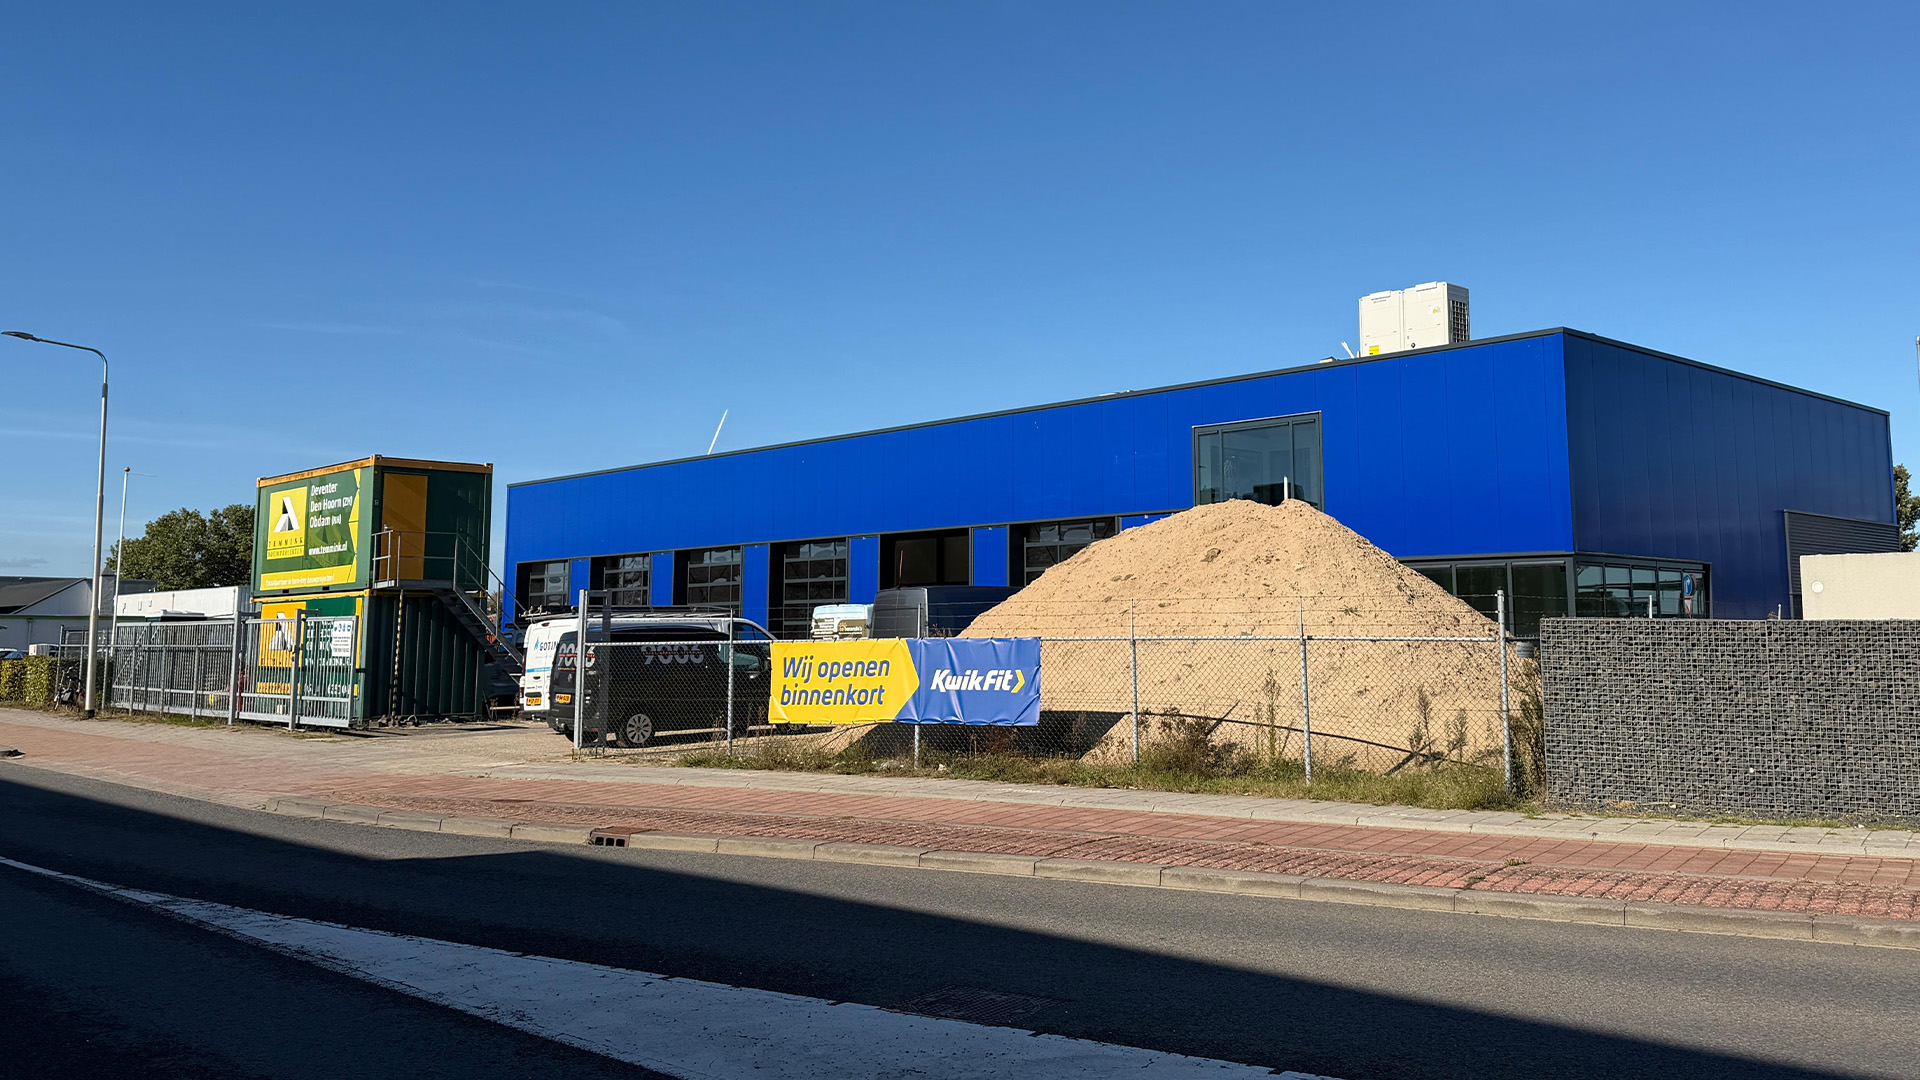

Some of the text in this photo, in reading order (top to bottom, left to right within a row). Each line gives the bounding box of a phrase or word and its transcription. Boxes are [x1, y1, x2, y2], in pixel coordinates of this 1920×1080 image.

[311, 483, 338, 496] Deventer
[310, 501, 322, 512] Den
[323, 498, 341, 509] Hoorn
[310, 515, 330, 528] Obdam
[308, 541, 347, 555] www.temmink.nl
[782, 656, 890, 684] Wij openen
[780, 685, 885, 706] binnenkort
